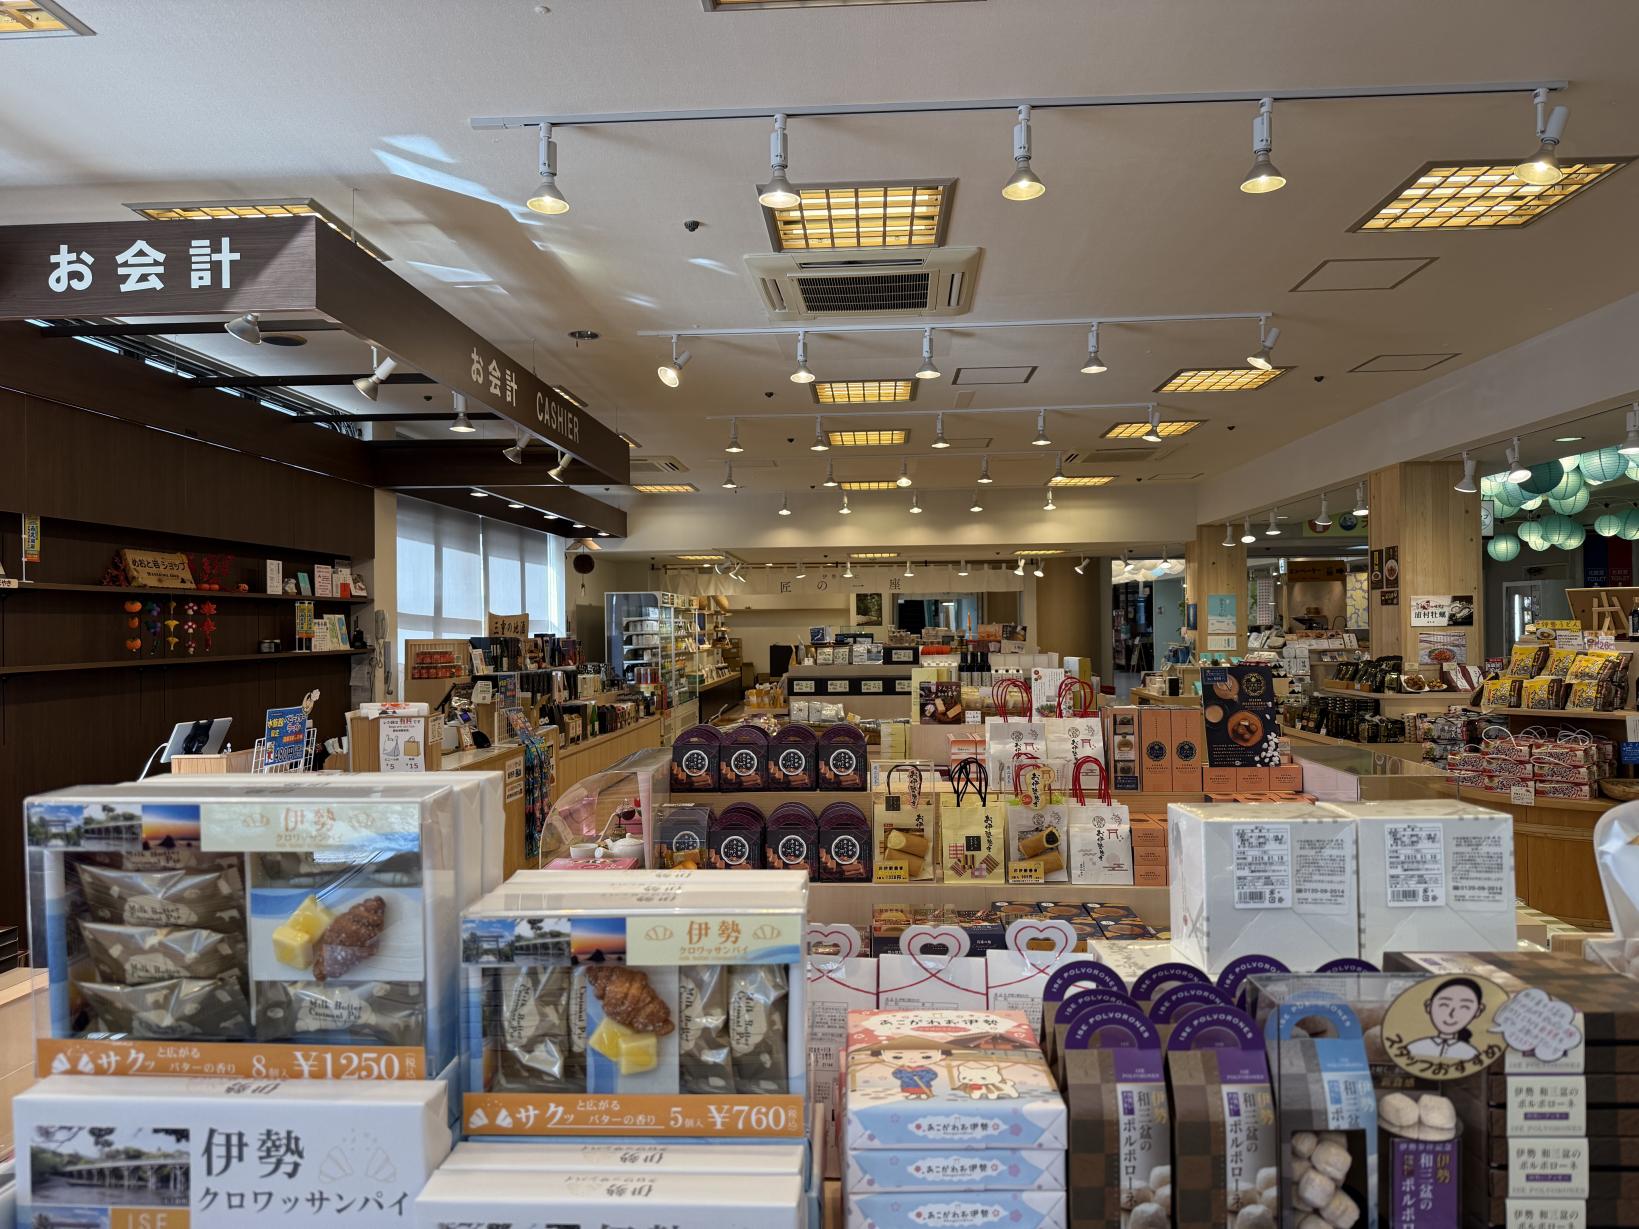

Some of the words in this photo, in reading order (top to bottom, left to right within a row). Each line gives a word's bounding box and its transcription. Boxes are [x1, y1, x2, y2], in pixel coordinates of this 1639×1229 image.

[48, 237, 240, 292] お会計
[471, 347, 517, 407] お会計
[536, 391, 579, 443] CASHIER
[688, 920, 742, 945] 伊勢
[680, 946, 748, 955] クロワッサンパイ
[1051, 977, 1066, 993] ISE
[1139, 979, 1151, 992] ISE
[1224, 973, 1236, 988] ISE
[1064, 999, 1079, 1017] ISE
[1158, 999, 1173, 1015] ISE
[879, 1017, 1000, 1027] あこがれお伊勢
[1075, 1022, 1089, 1040] ISE
[1088, 1011, 1150, 1040] POLVORONES
[1178, 1023, 1192, 1042] ISE
[1191, 1012, 1254, 1040] POLVORONES
[157, 1048, 200, 1058] と広がる
[1385, 1033, 1502, 1077] スタッフおすすめ
[169, 1063, 236, 1074] バターの香り
[292, 1050, 400, 1080] ¥1250
[1513, 1086, 1535, 1097] 伊勢
[1539, 1086, 1579, 1097] 和三盆の
[576, 1100, 620, 1111] と広がる
[516, 1103, 574, 1128] サクッ
[589, 1114, 656, 1125] バターの香り
[707, 1105, 786, 1130] ¥760
[1137, 1090, 1153, 1152] 和三盆の
[1242, 1092, 1259, 1153] 和三盆の
[927, 1122, 989, 1132] あこがれお伊勢
[201, 1127, 305, 1180] 伊勢
[1515, 1148, 1537, 1159] 伊勢
[1541, 1148, 1581, 1159] 和三盆の
[926, 1163, 987, 1174] あこがれお伊勢
[1436, 1152, 1450, 1184] 伊勢
[1418, 1153, 1434, 1211] 和三盆の
[200, 1187, 410, 1217] クロワッサンパイ
[927, 1207, 989, 1219] あこがれお伊勢
[1514, 1210, 1535, 1221] 伊勢
[1539, 1210, 1579, 1221] 和三盆の
